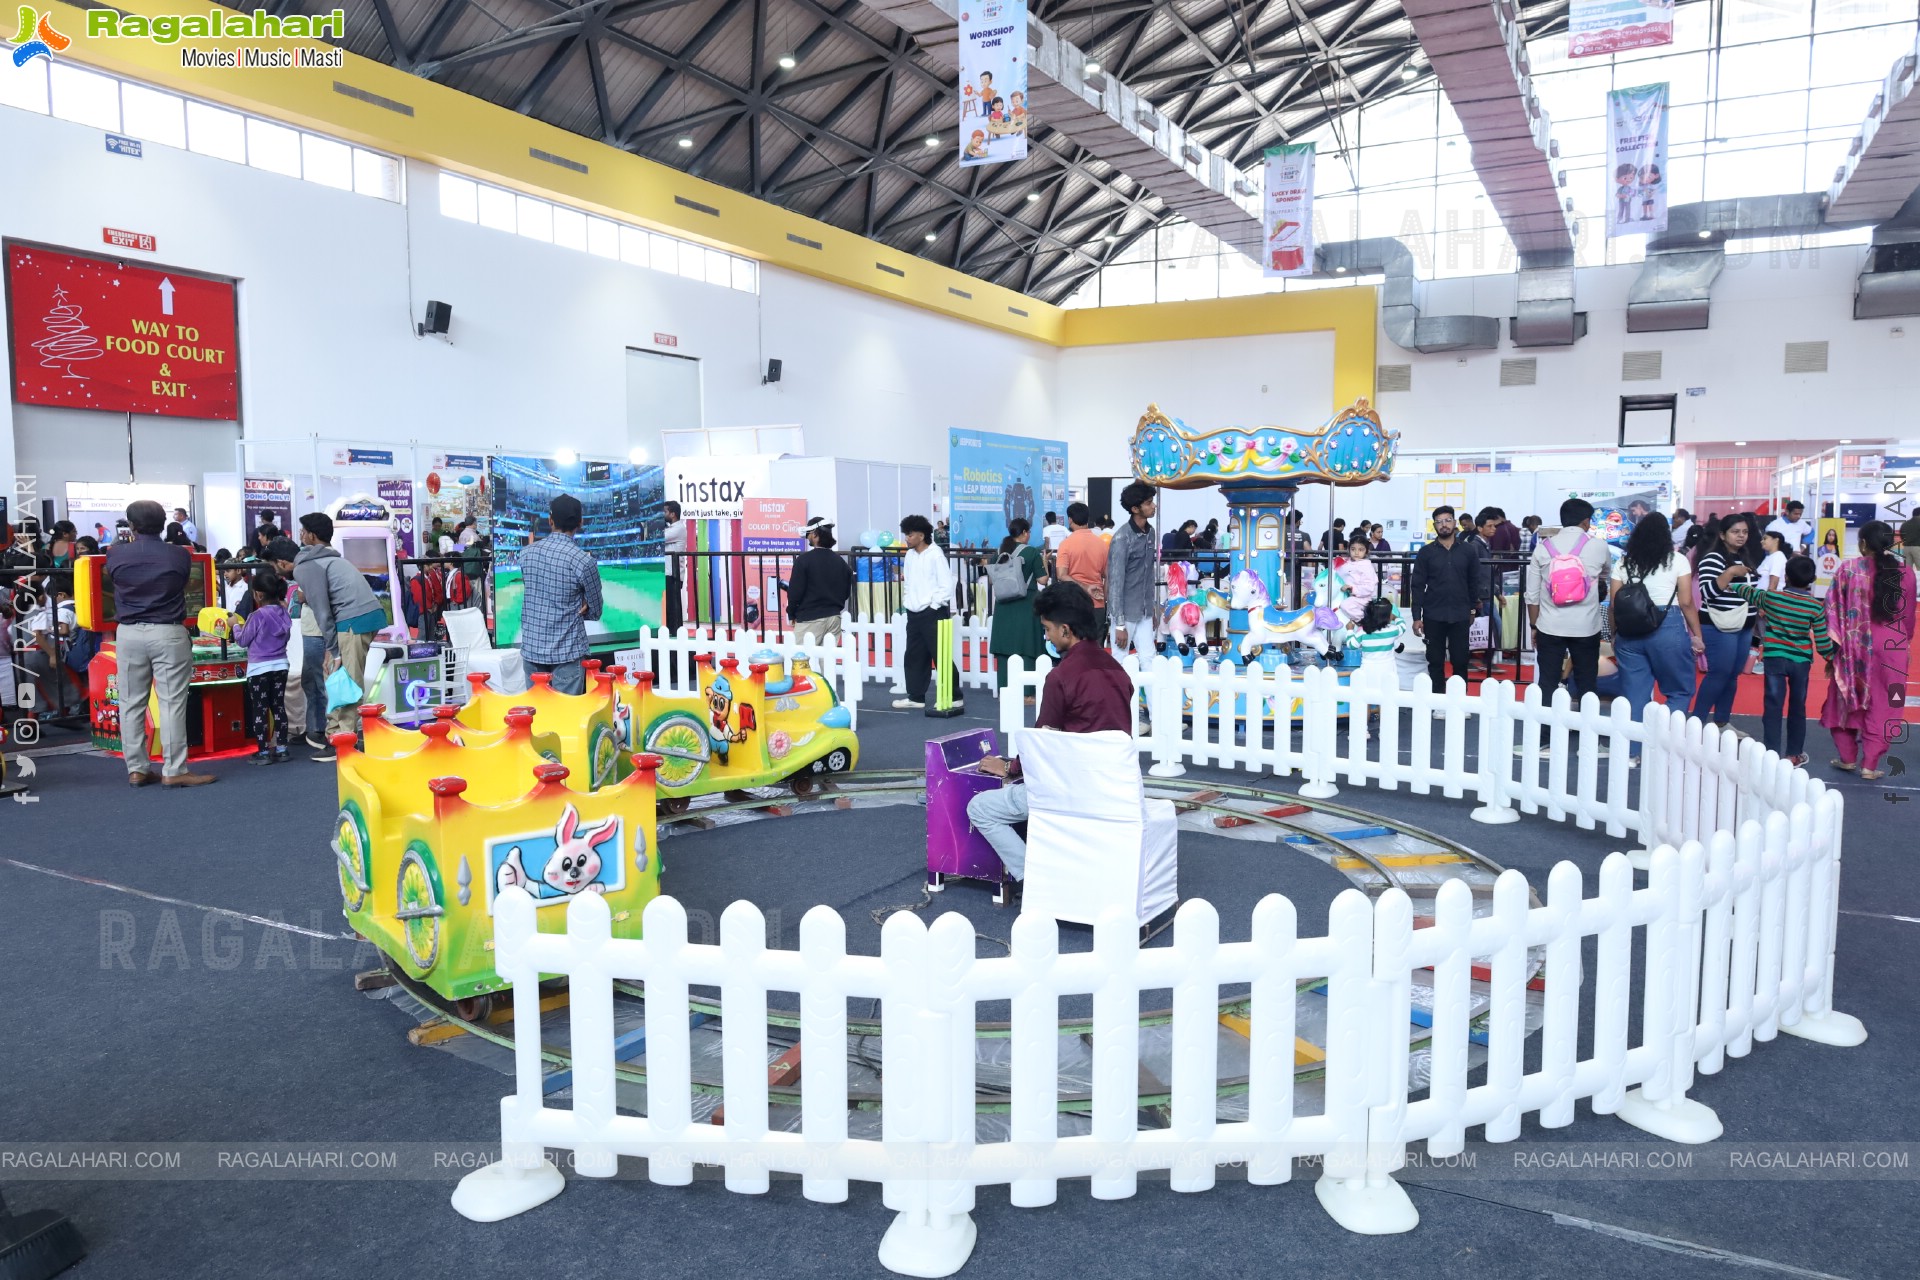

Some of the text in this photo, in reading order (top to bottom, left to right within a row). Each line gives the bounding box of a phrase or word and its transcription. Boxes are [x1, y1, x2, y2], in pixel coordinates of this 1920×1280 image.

[1588, 18, 1623, 30] Primary
[969, 25, 1015, 41] WORKSHOP
[981, 38, 1002, 49] ZONE
[1616, 141, 1659, 153] COLLECTIN
[1275, 195, 1303, 204] SPONSOR
[112, 235, 135, 247] EXIT
[131, 318, 199, 342] WAY TO
[106, 335, 226, 364] FOOD COURT
[159, 363, 172, 377] &
[151, 380, 187, 398] EXIT
[963, 466, 1003, 484] Robotics
[245, 480, 275, 491] LEARN
[678, 473, 746, 503] instax
[963, 485, 979, 494] LEAP
[979, 485, 1003, 495] ROBOTS
[245, 493, 268, 501] DOING
[759, 501, 785, 513] instax
[683, 509, 700, 518] don't
[700, 509, 714, 519] just
[715, 509, 732, 518] take,
[748, 524, 770, 532] COLOR
[771, 524, 781, 532] TO
[748, 539, 761, 547] Color
[631, 661, 637, 671] 2
